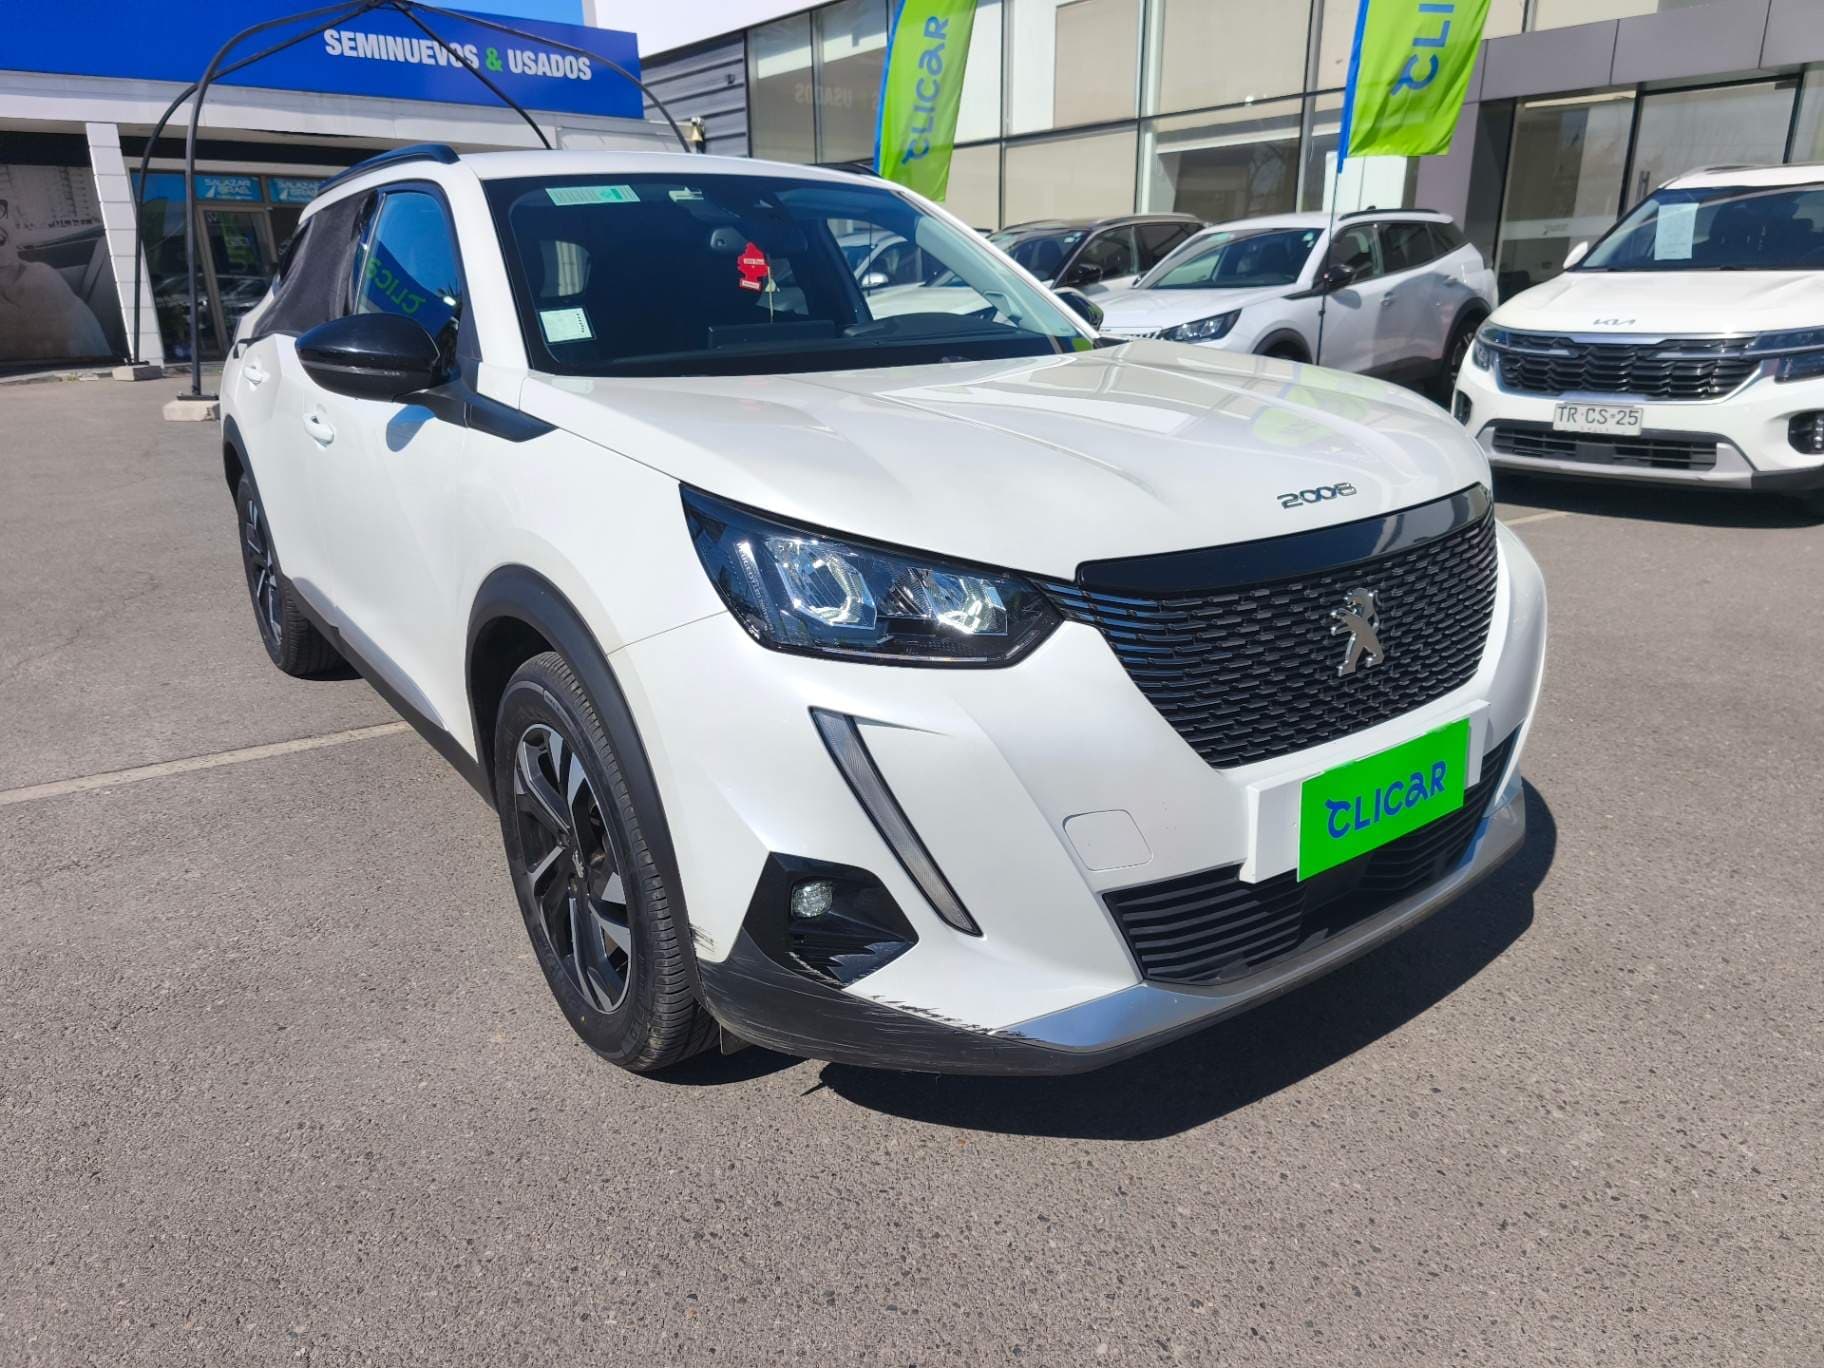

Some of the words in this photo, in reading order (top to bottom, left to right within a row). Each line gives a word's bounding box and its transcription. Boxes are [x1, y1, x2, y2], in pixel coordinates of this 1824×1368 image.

[324, 29, 479, 69] SEMINUEVOS
[485, 48, 503, 71] &
[507, 49, 592, 80] USADOS
[1277, 482, 1357, 509] 2008
